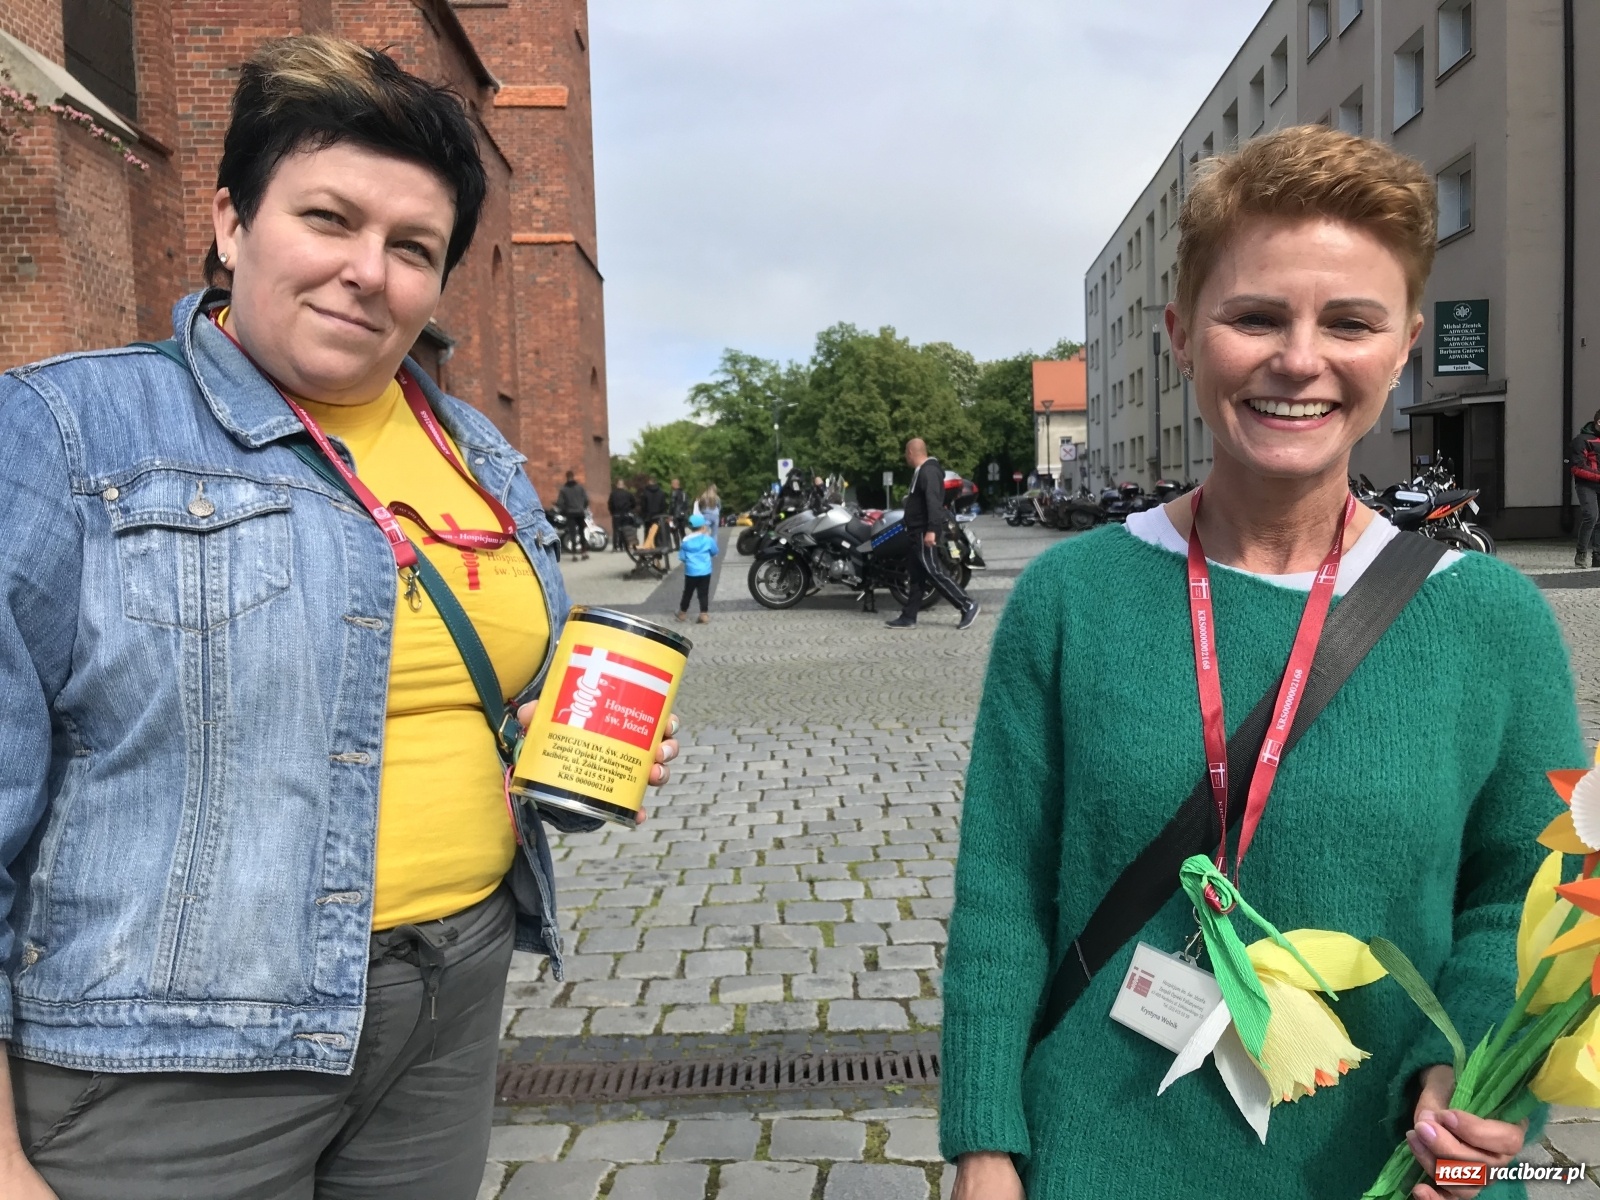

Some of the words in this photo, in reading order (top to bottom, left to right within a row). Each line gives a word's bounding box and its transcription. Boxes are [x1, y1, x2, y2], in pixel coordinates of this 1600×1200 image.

[460, 533, 498, 544] Hospicjum
[486, 551, 528, 562] Hospicju
[494, 566, 510, 576] św.
[1198, 610, 1210, 670] KRS0000002168
[1276, 669, 1302, 730] KRS0000002168
[604, 698, 654, 724] Hospicjum
[605, 714, 620, 726] św.
[622, 719, 649, 736] Józefa
[547, 732, 590, 749] HOSPICJUM
[591, 742, 604, 753] IM.
[605, 746, 618, 758] ŚW.
[619, 751, 642, 766] JÓZEFA
[552, 742, 573, 754] Zespół
[574, 748, 597, 760] Opieki
[599, 755, 633, 773] Paliatywnej
[558, 772, 574, 781] KRS
[562, 764, 572, 772] tel.
[574, 767, 582, 775] 32
[584, 769, 596, 778] 415
[571, 756, 580, 765] ul.
[582, 759, 626, 780] Żółkiewskiego
[1141, 1005, 1160, 1020] Krystyna
